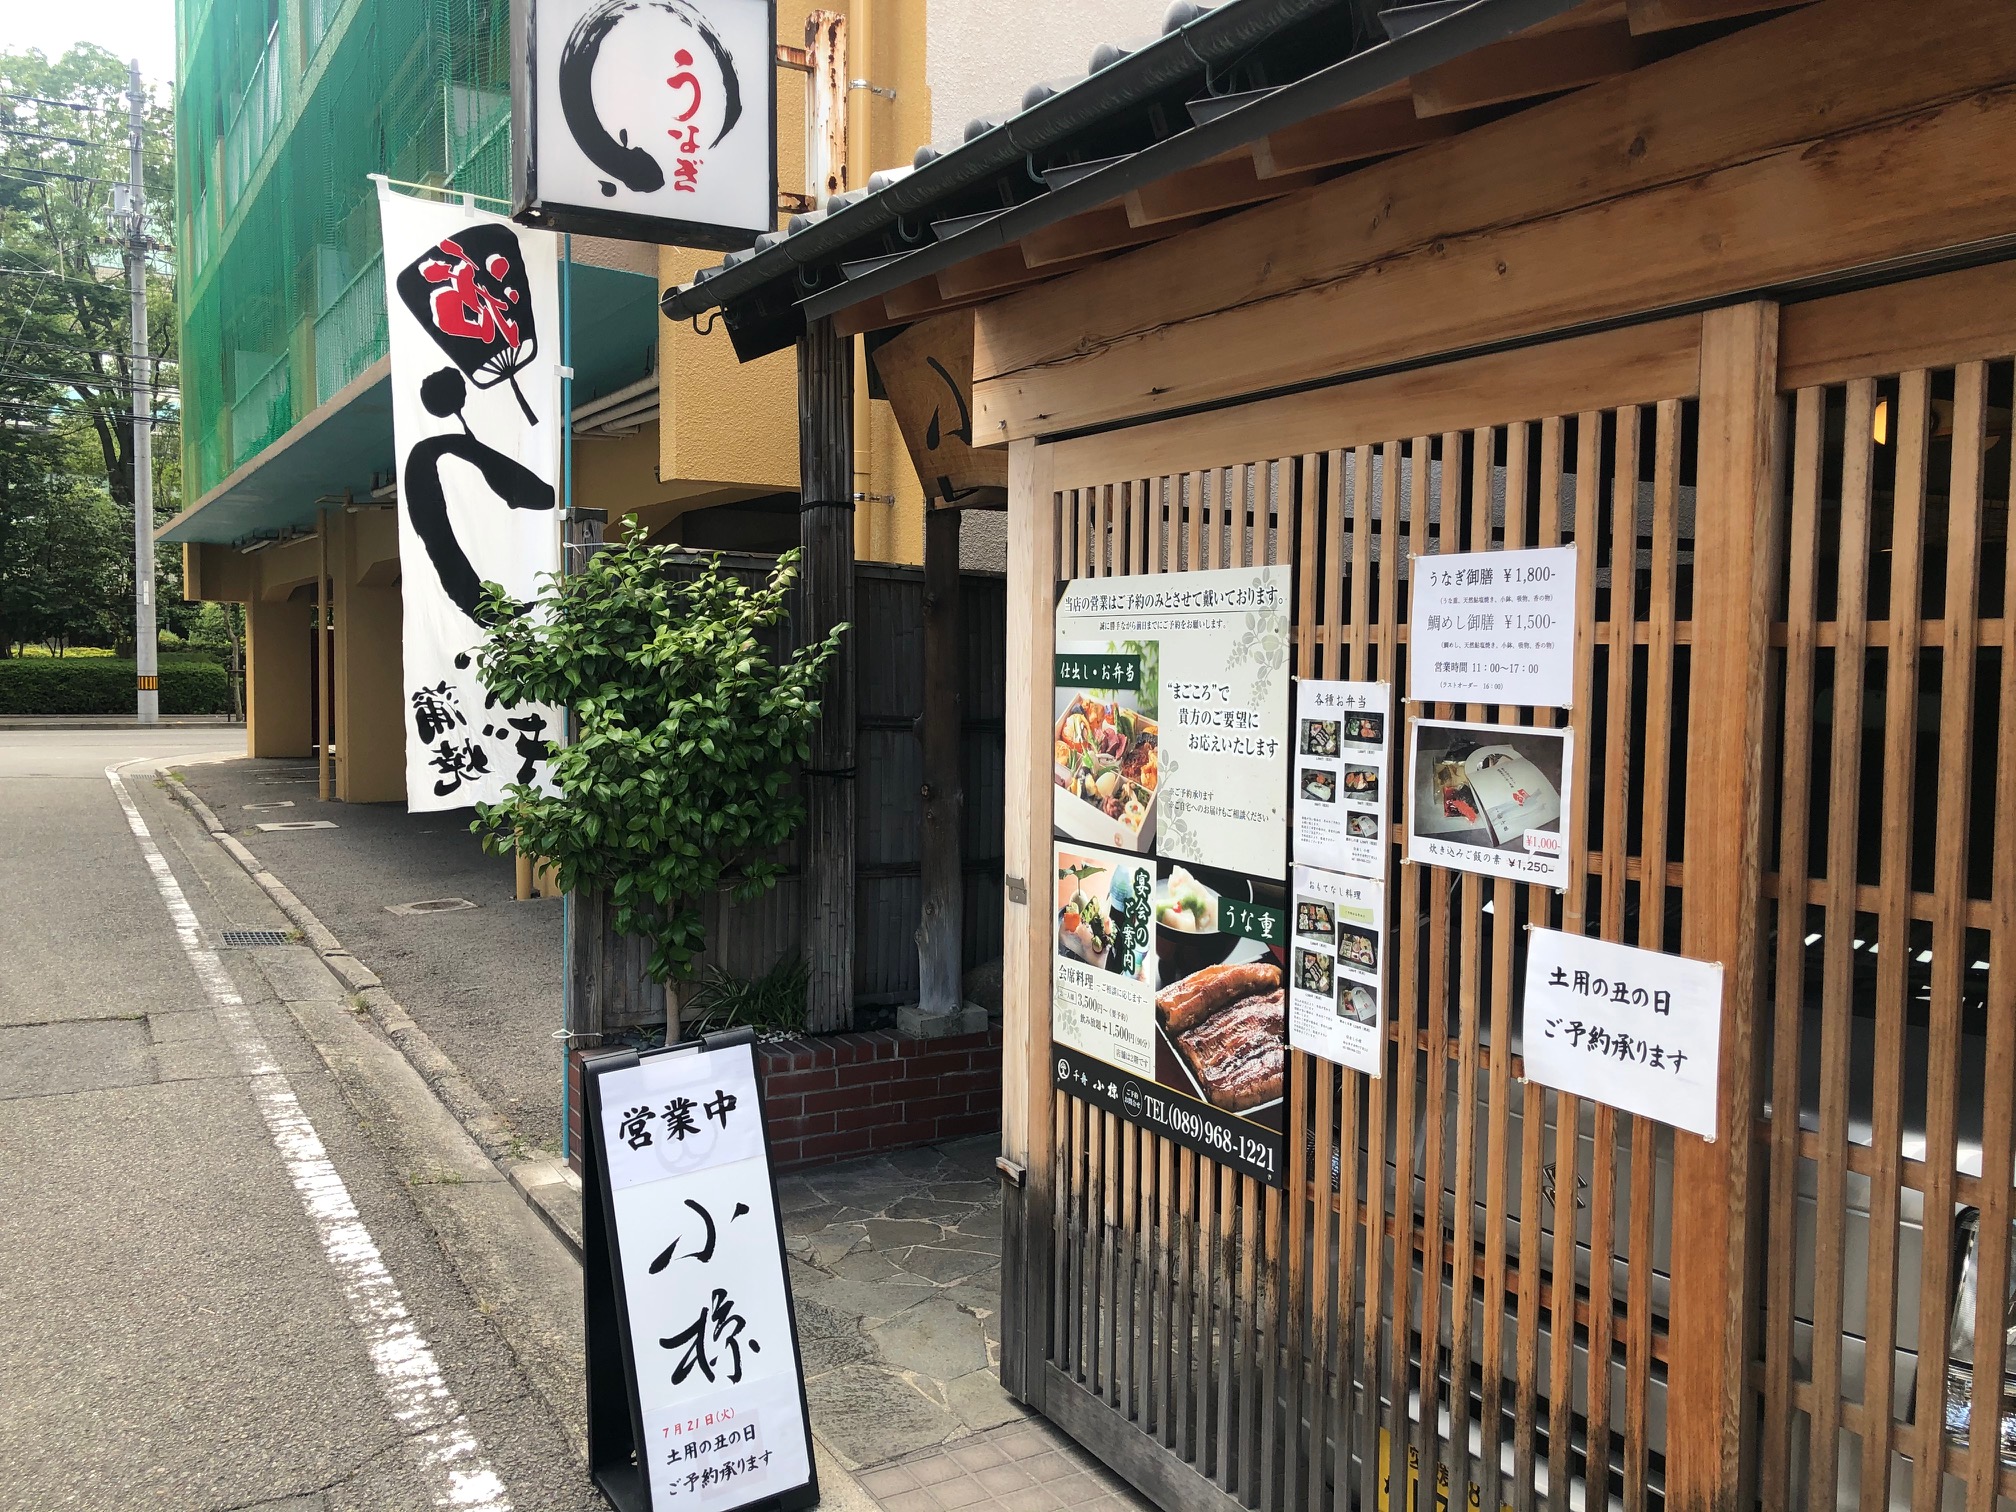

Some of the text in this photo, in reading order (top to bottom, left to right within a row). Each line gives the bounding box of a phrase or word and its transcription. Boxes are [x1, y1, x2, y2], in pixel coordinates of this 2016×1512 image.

[667, 48, 704, 193] うなぎ
[1430, 568, 1494, 587] うなぎ御膳
[1064, 586, 1283, 612] 当店の営業はご予約のみとさせて戴いております。
[1427, 613, 1495, 631] 鯛めし御膳
[1060, 661, 1135, 684] 仕出し・お弁当
[1434, 661, 1468, 674] 営業時間
[1314, 693, 1367, 709] 各種お弁当
[1178, 708, 1259, 729] 貴方のご要望に
[1188, 733, 1279, 758] お応えいたします
[1429, 843, 1502, 865] 炊き込みご飯の素
[1309, 881, 1362, 900] おもてなし料理
[1135, 872, 1149, 944] 宴会の
[1226, 905, 1276, 939] うな重
[1122, 900, 1136, 971] ご案内
[1058, 964, 1094, 991] 会席料理
[1548, 965, 1671, 1016] 土用の丑の日
[1545, 1018, 1688, 1074] ご予約承ります
[619, 1089, 738, 1151] 営業中
[666, 1424, 756, 1466] 土用の丑の日
[669, 1449, 774, 1496] ご予約承ります
